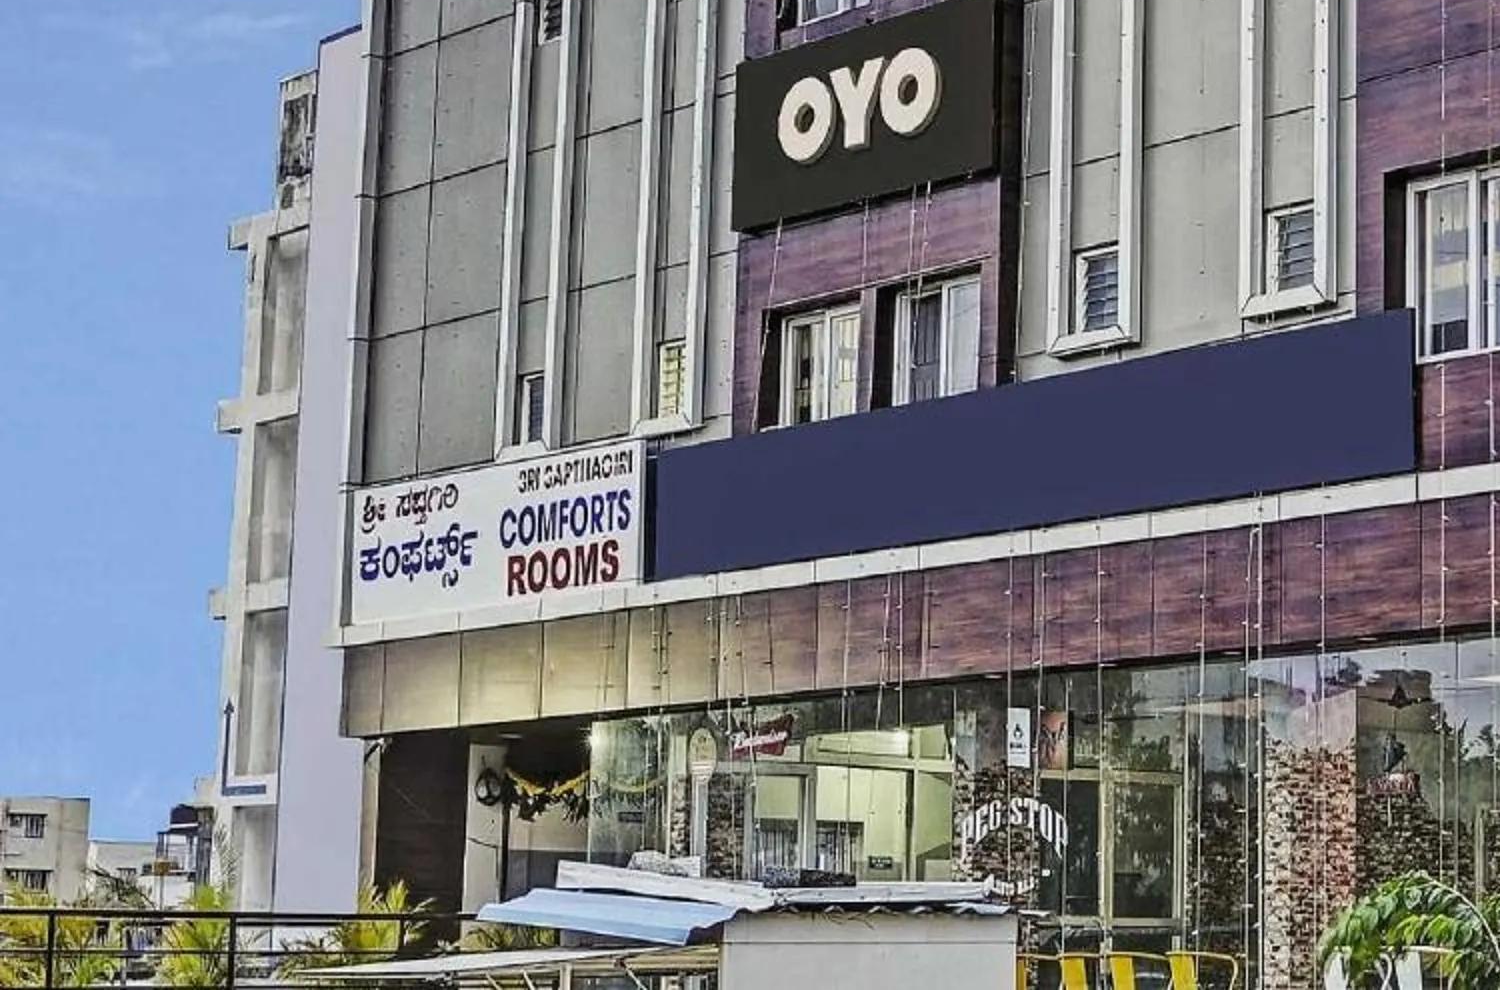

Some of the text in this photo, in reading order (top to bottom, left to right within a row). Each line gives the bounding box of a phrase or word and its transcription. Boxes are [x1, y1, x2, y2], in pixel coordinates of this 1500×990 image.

[777, 46, 942, 165] OYO
[518, 449, 634, 495] SRI SAPTHAGIRI
[360, 494, 386, 534] ಶ್ರೀ
[499, 488, 632, 548] COMFORTS
[506, 538, 620, 597] ROOMS
[1010, 796, 1068, 859] STOP
